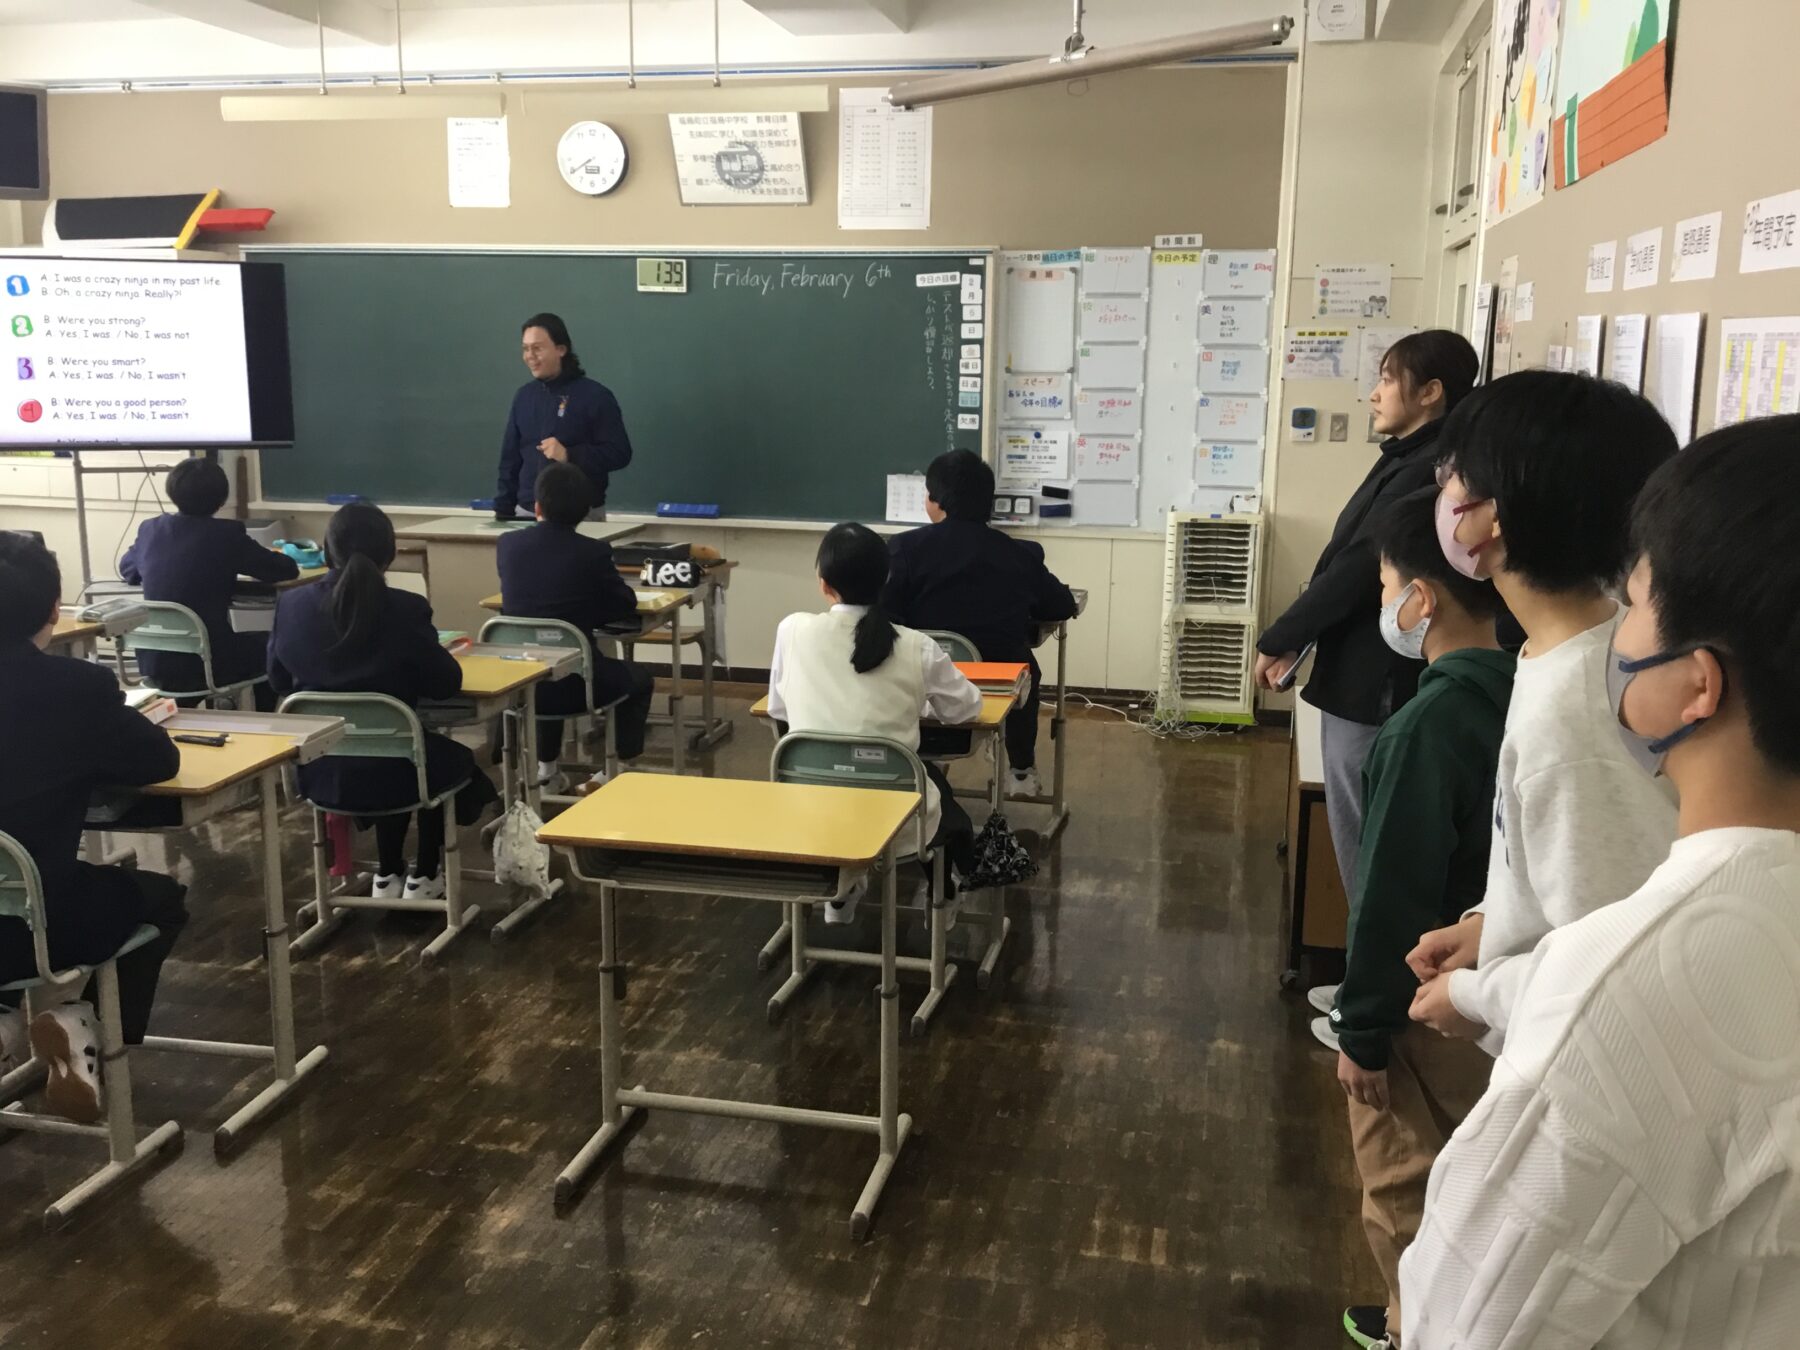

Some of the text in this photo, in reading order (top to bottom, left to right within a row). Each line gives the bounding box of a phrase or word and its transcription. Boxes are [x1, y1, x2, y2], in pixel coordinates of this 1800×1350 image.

[1162, 236, 1196, 246] 時間割
[1156, 254, 1197, 262] 今日の予定
[54, 273, 61, 282] I
[63, 275, 82, 283] was
[85, 276, 92, 284] a
[94, 276, 121, 286] crazy
[124, 276, 149, 287] ninja
[152, 276, 161, 285] in
[163, 277, 177, 287] my
[179, 276, 201, 287] past
[713, 262, 891, 298] Friday, February 6th
[920, 274, 957, 284] 今日の目標
[85, 290, 112, 299] crazy
[968, 291, 975, 300] 月
[57, 316, 85, 325] Were
[88, 317, 106, 326] you
[108, 316, 146, 328] strong?
[968, 326, 976, 334] 日
[153, 331, 172, 340] was
[61, 357, 89, 366] Were
[91, 359, 109, 368] you
[111, 357, 146, 367] smart?
[961, 362, 978, 370] 曜日
[1023, 378, 1053, 386] スピーチ
[64, 397, 92, 407] Were
[95, 399, 112, 408] you
[122, 397, 147, 409] good
[148, 397, 187, 408] person?
[960, 417, 977, 425] 欠席
[647, 561, 692, 586] Lee
